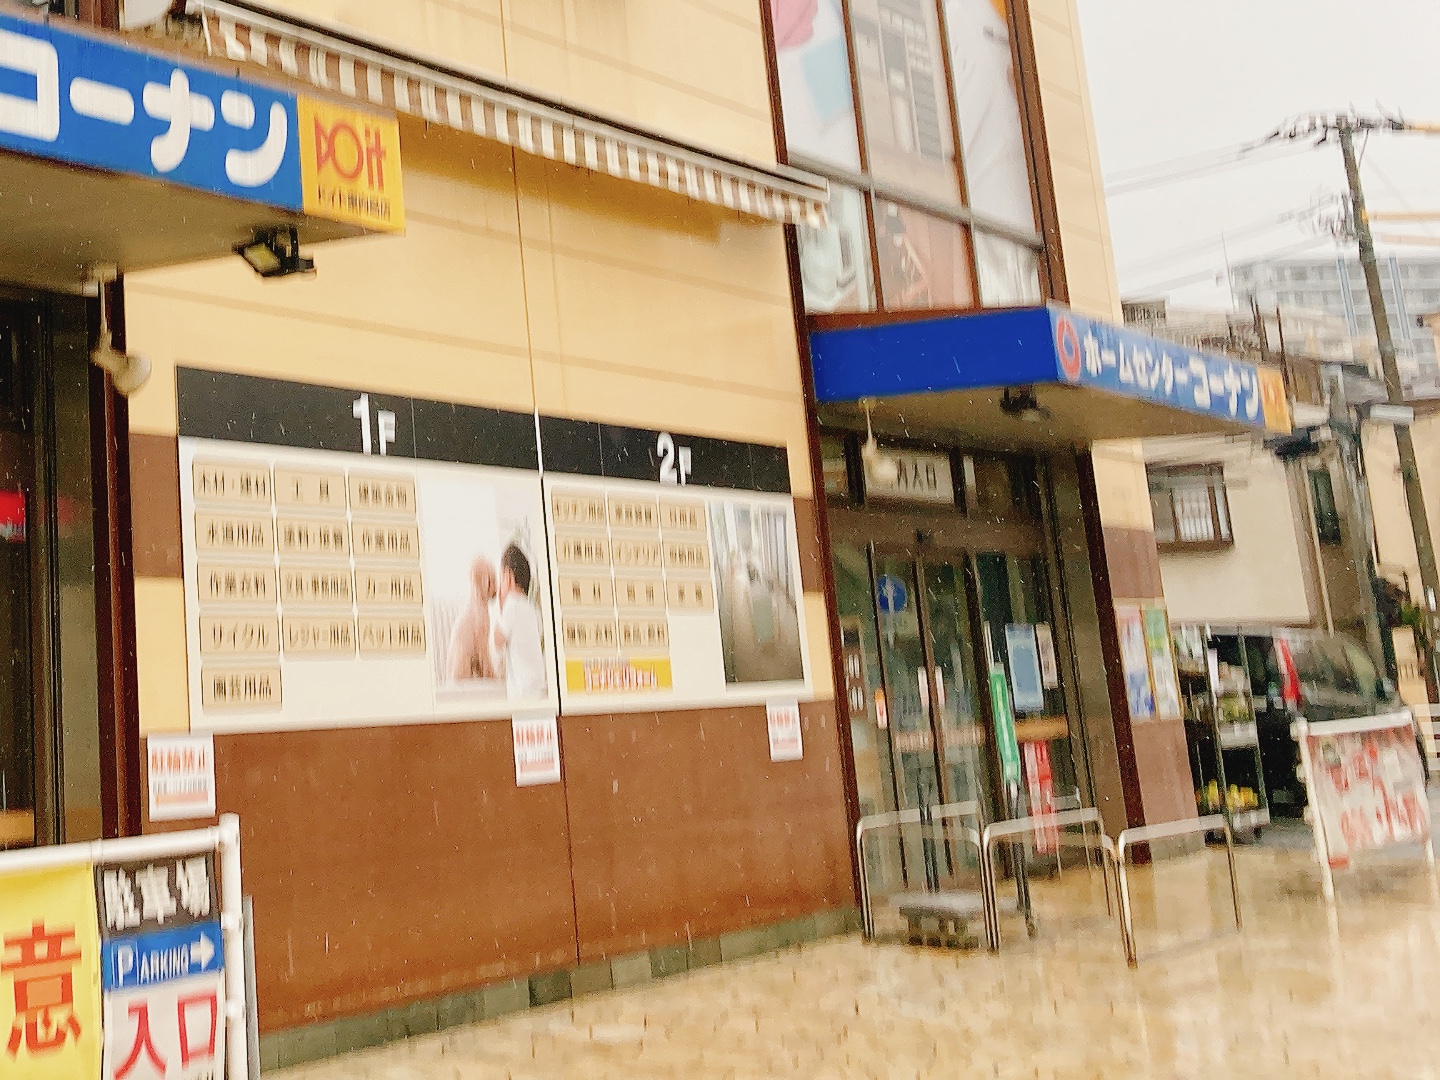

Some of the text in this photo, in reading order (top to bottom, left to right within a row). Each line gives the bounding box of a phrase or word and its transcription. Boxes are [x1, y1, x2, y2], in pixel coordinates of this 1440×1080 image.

[353, 393, 396, 457] 1F
[657, 431, 692, 488] 2F
[112, 989, 218, 1080] 入口
